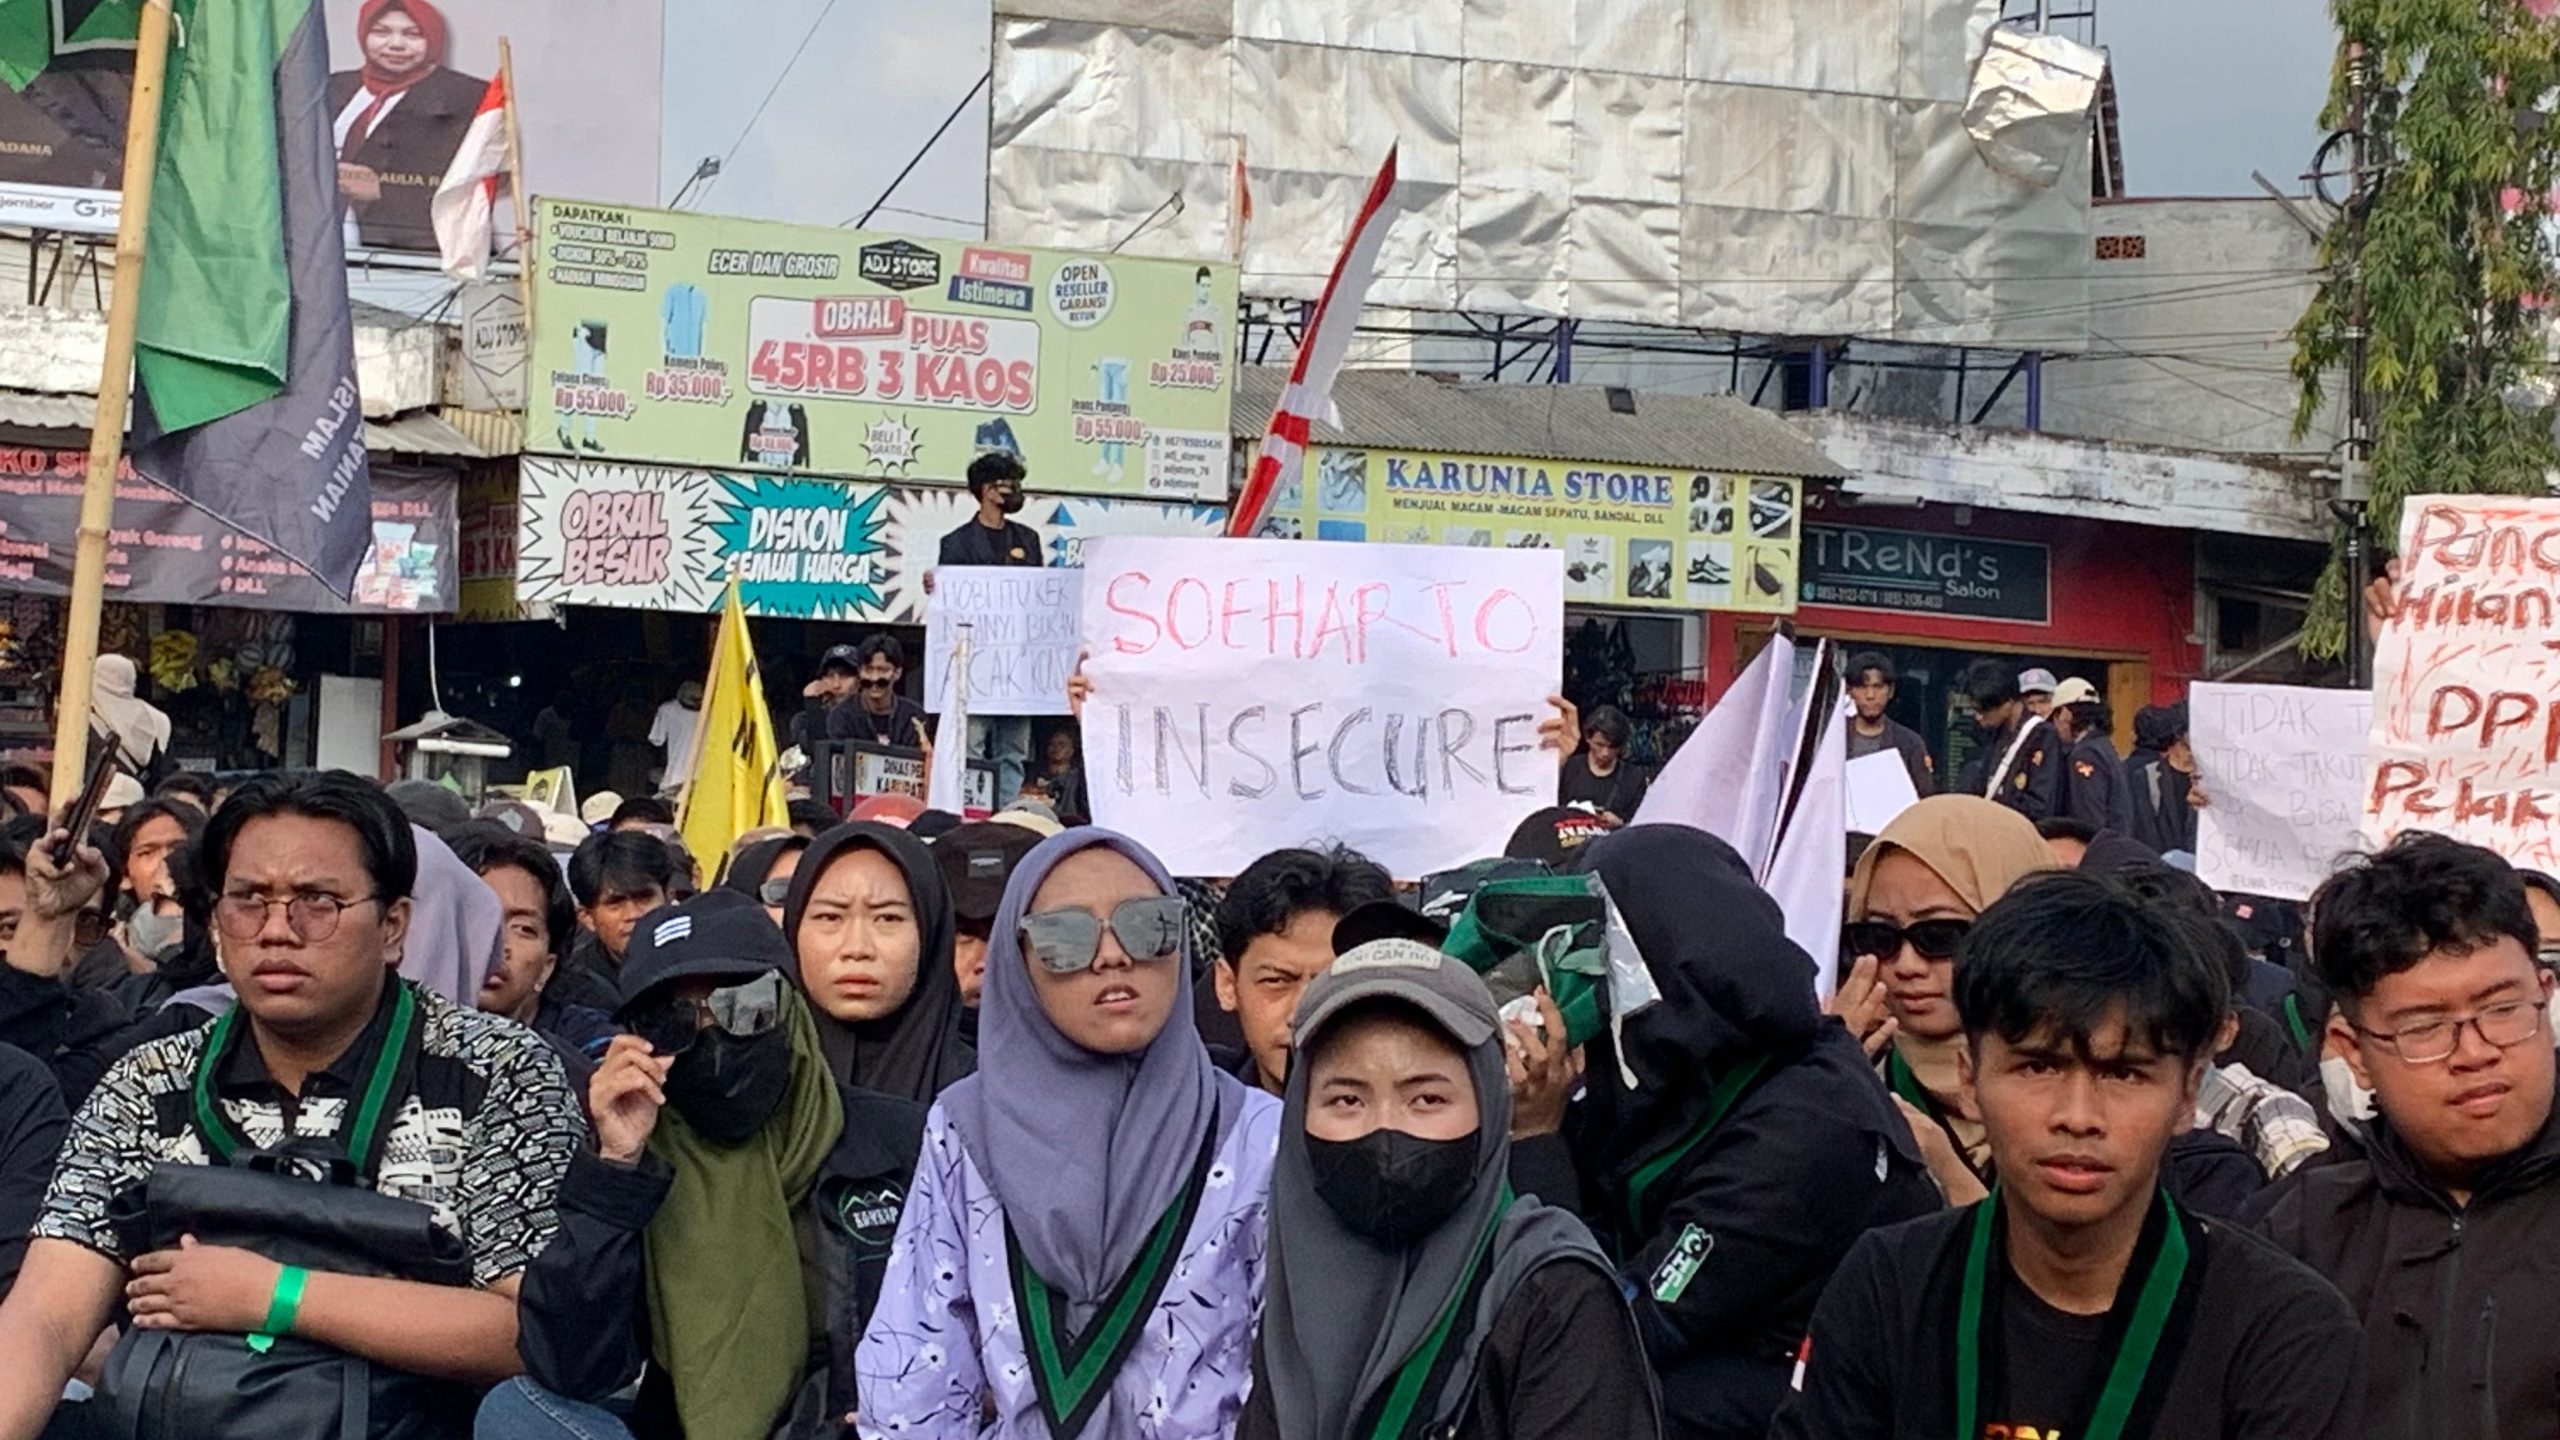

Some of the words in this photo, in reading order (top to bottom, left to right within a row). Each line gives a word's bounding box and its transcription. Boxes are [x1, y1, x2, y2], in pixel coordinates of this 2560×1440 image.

[553, 205, 625, 224] DAPATKAN
[708, 249, 748, 274] ECER
[750, 252, 782, 278] DAN
[784, 253, 840, 280] GROSIR
[862, 254, 891, 273] ADJ
[892, 257, 938, 277] STORE
[968, 252, 1026, 279] Kwalitas
[1061, 264, 1099, 282] OPEN
[958, 279, 1027, 307] Istimewa
[1055, 281, 1108, 297] RESELLER
[822, 300, 894, 331] OBRAL
[910, 316, 989, 355] PUAS
[645, 372, 666, 396] Rp
[750, 338, 867, 394] 45RB
[876, 349, 904, 398] 3
[914, 352, 1034, 410] KAOS
[1385, 458, 1554, 498] KARUNIA
[1564, 470, 1674, 507] STORE
[561, 489, 669, 541] OBRAL
[1393, 498, 1447, 513] MENJUAL
[1450, 500, 1494, 514] MACAM
[747, 505, 849, 552] DISKON
[561, 535, 672, 587] BESAR
[724, 550, 797, 584] SEMUA
[801, 553, 871, 586] HARGA
[1945, 579, 2001, 600] Salon
[2393, 574, 2560, 632] Hilan
[1105, 570, 1539, 665] SOEHARTO
[1115, 701, 1537, 806] INSECURE
